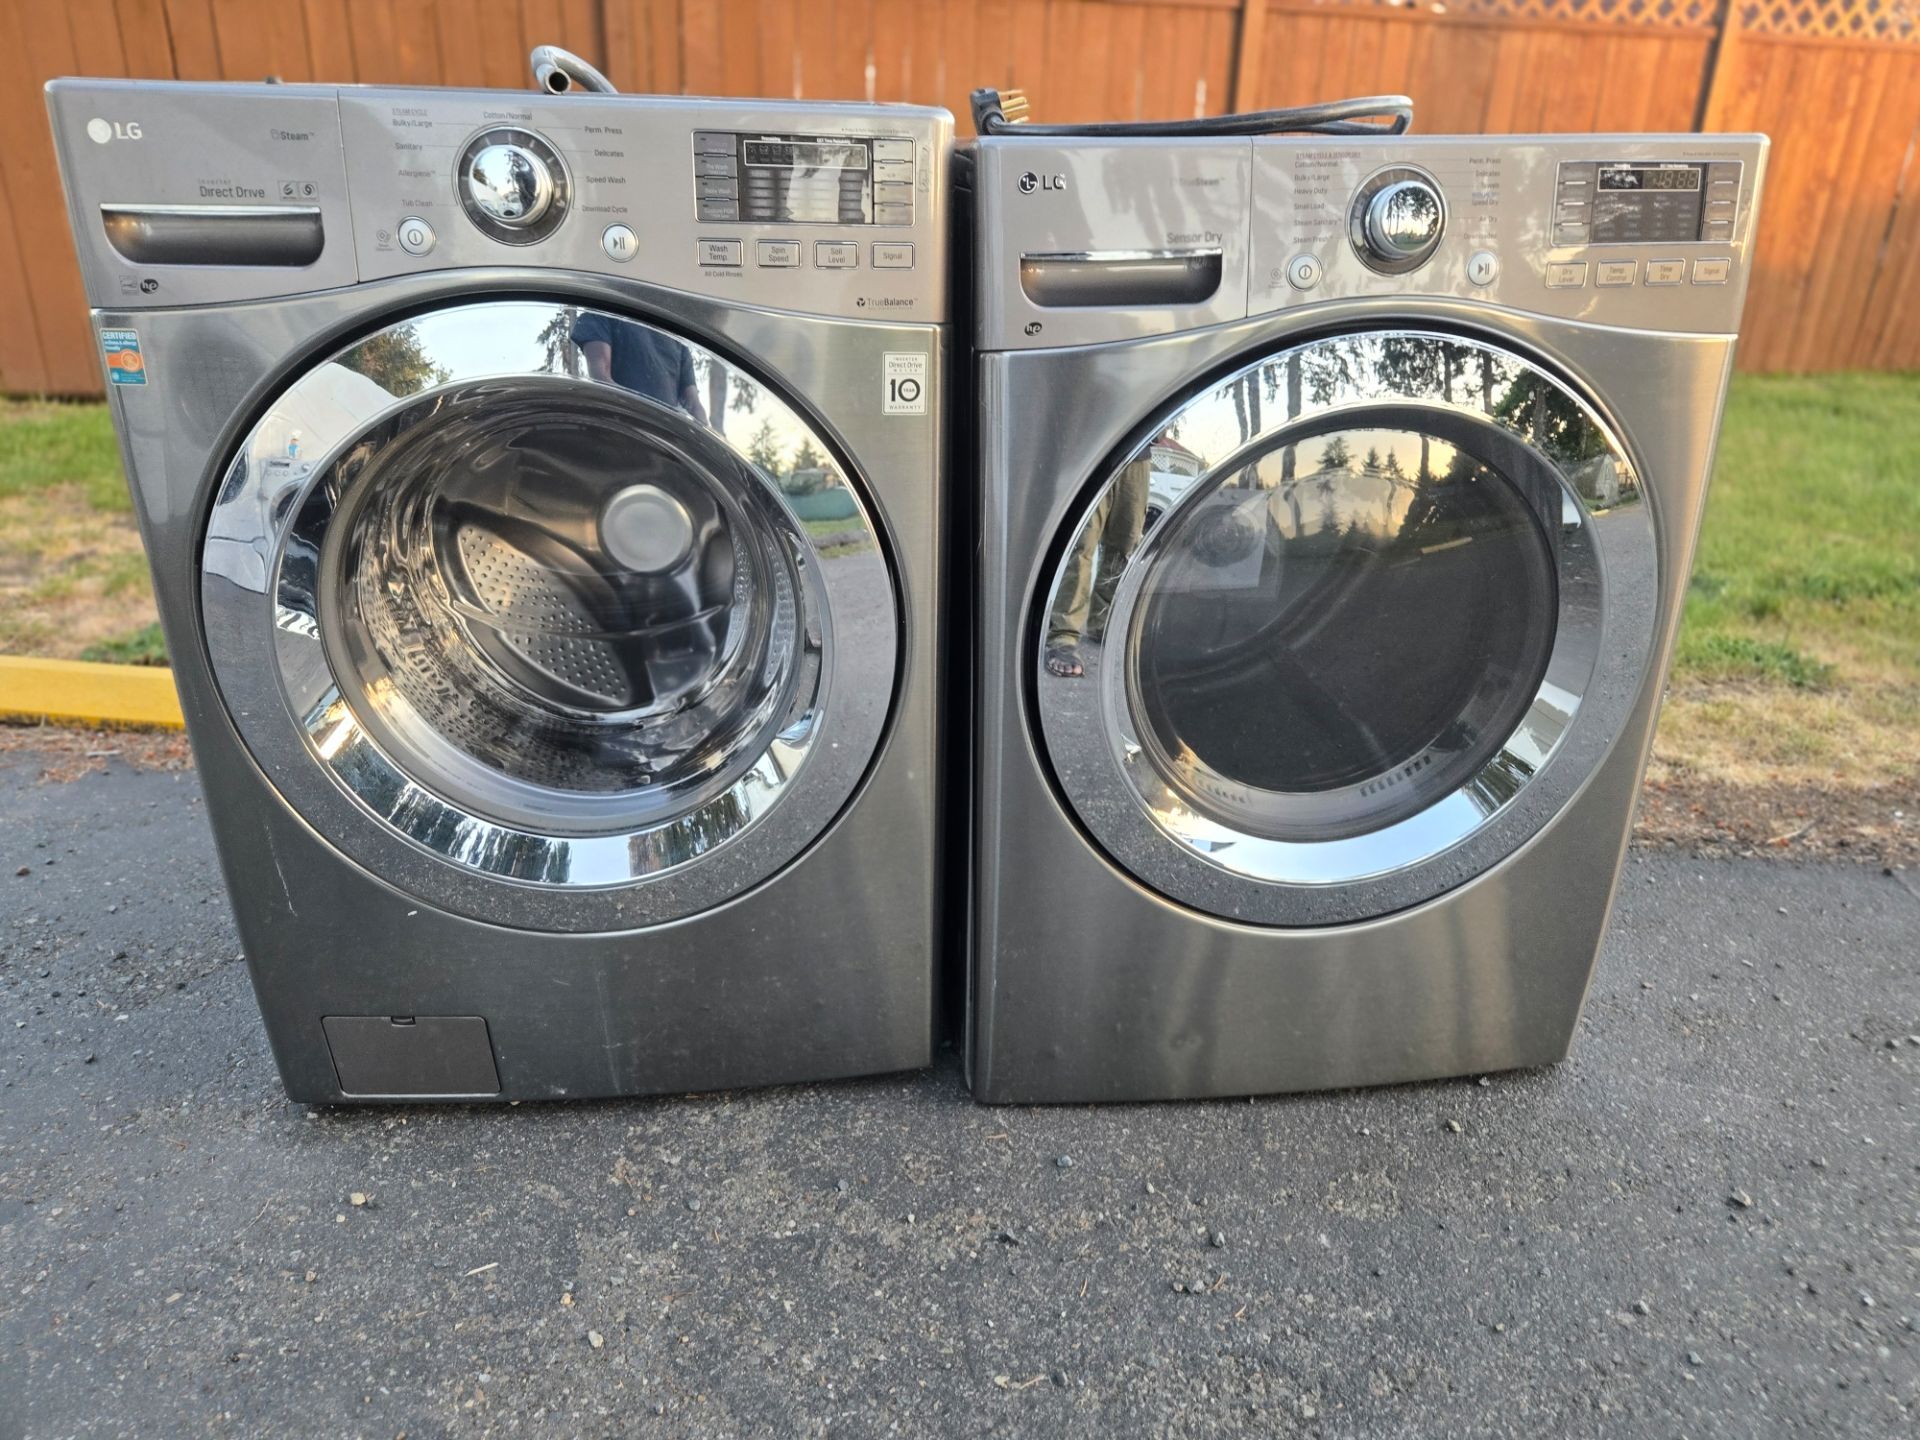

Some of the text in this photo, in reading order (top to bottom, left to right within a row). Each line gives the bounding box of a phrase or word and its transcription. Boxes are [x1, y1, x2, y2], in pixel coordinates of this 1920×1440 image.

[483, 111, 533, 121] Cotton/Normal
[392, 119, 433, 128] Bulky/Large
[113, 121, 143, 140] LG
[604, 126, 623, 135] Press
[280, 131, 309, 141] Steam
[394, 142, 423, 151] Sanitary
[594, 149, 624, 158] Delicates
[586, 176, 626, 185] Speed Wash
[1042, 174, 1066, 190] LG
[200, 186, 265, 198] Direct Drive
[402, 199, 433, 207] Tub Clean
[1167, 230, 1223, 245] Sensor Dry
[709, 244, 729, 253] Wash
[770, 246, 787, 256] Spin
[829, 247, 843, 256] Soil
[768, 253, 790, 264] Speed
[827, 255, 846, 264] Level
[882, 252, 903, 261] Signal
[867, 297, 914, 306] TrueBalance
[907, 361, 923, 369] Drive
[890, 378, 921, 402] 10
